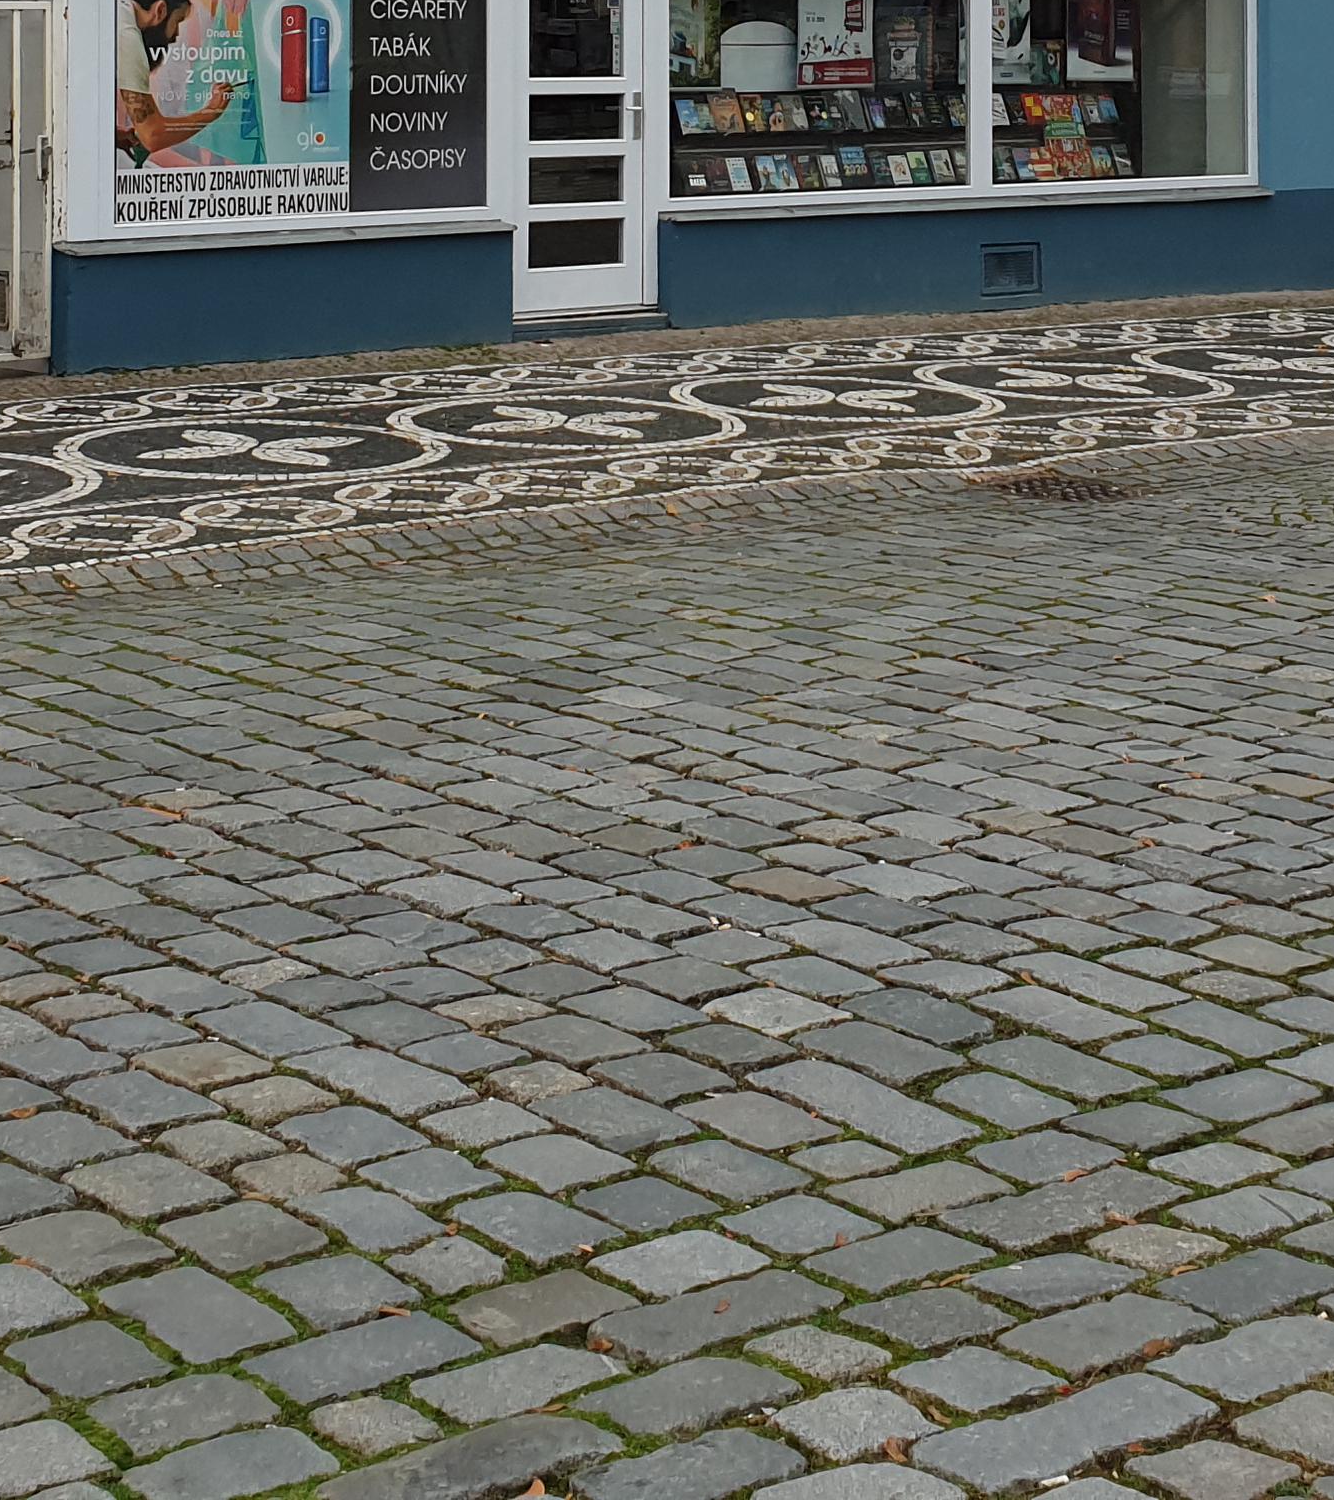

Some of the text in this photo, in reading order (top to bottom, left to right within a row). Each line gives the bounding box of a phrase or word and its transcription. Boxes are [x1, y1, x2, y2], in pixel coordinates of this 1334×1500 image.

[370, 0, 467, 20] CIGARETY
[206, 29, 231, 38] Dnes
[370, 32, 431, 57] TABÁK
[150, 41, 245, 64] vystoupím
[186, 67, 248, 84] z davu
[370, 70, 467, 95] DOUTNÍKY
[370, 111, 448, 132] NOVINY
[297, 123, 326, 151] glo
[370, 145, 467, 171] ČASOPISY
[117, 165, 348, 195] MINISTERSTVO ZDRAVOTNICTVÍ VARUJE:
[117, 192, 348, 222] KOUŘENÍ ZPŮSOBUJE RAKOVINU
